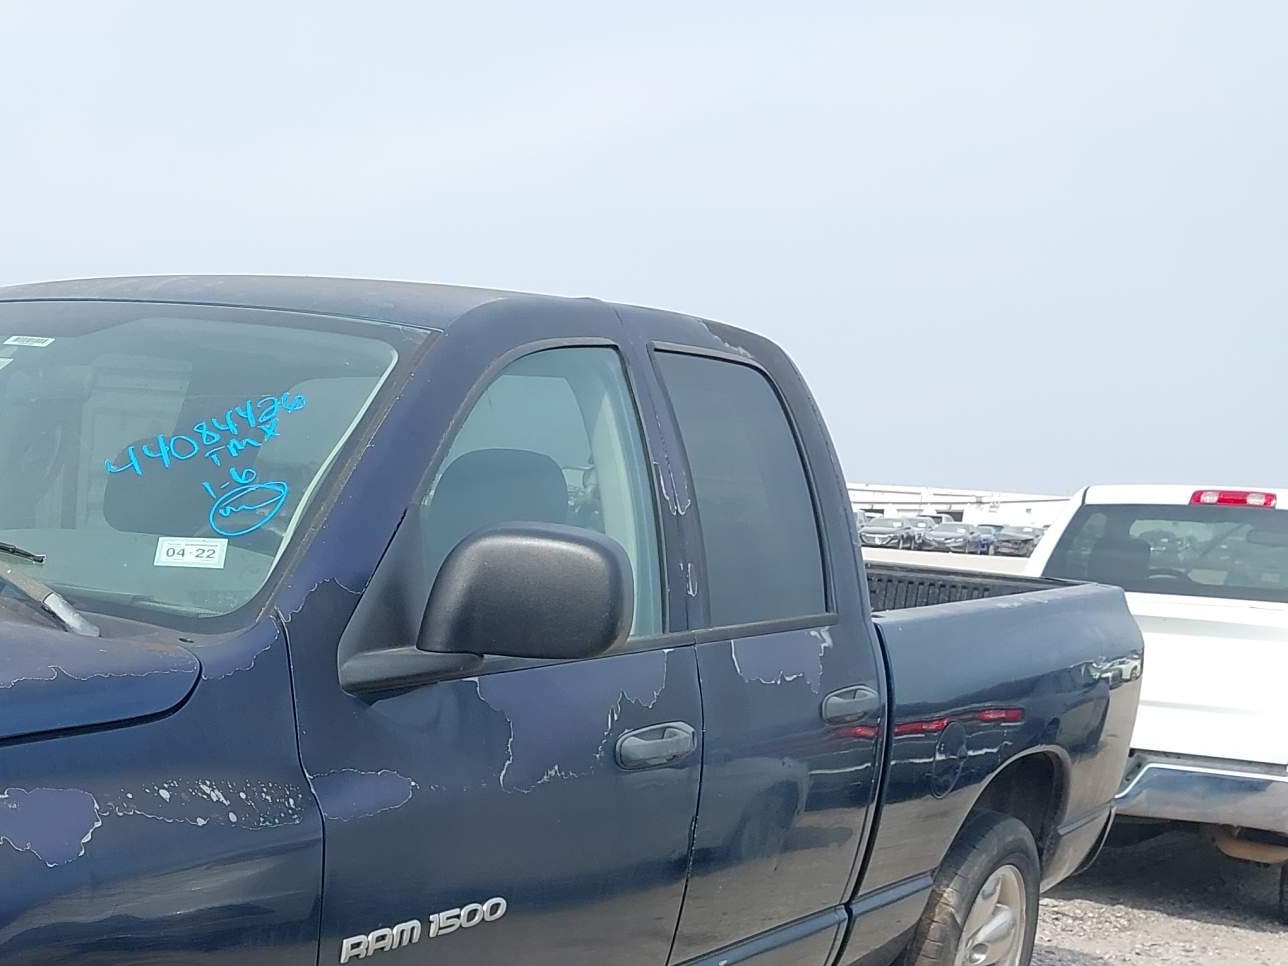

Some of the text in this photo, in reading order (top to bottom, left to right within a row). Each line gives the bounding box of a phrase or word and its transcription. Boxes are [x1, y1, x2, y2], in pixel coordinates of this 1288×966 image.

[104, 392, 306, 476] 44084426
[340, 896, 508, 964] RAM 1500
